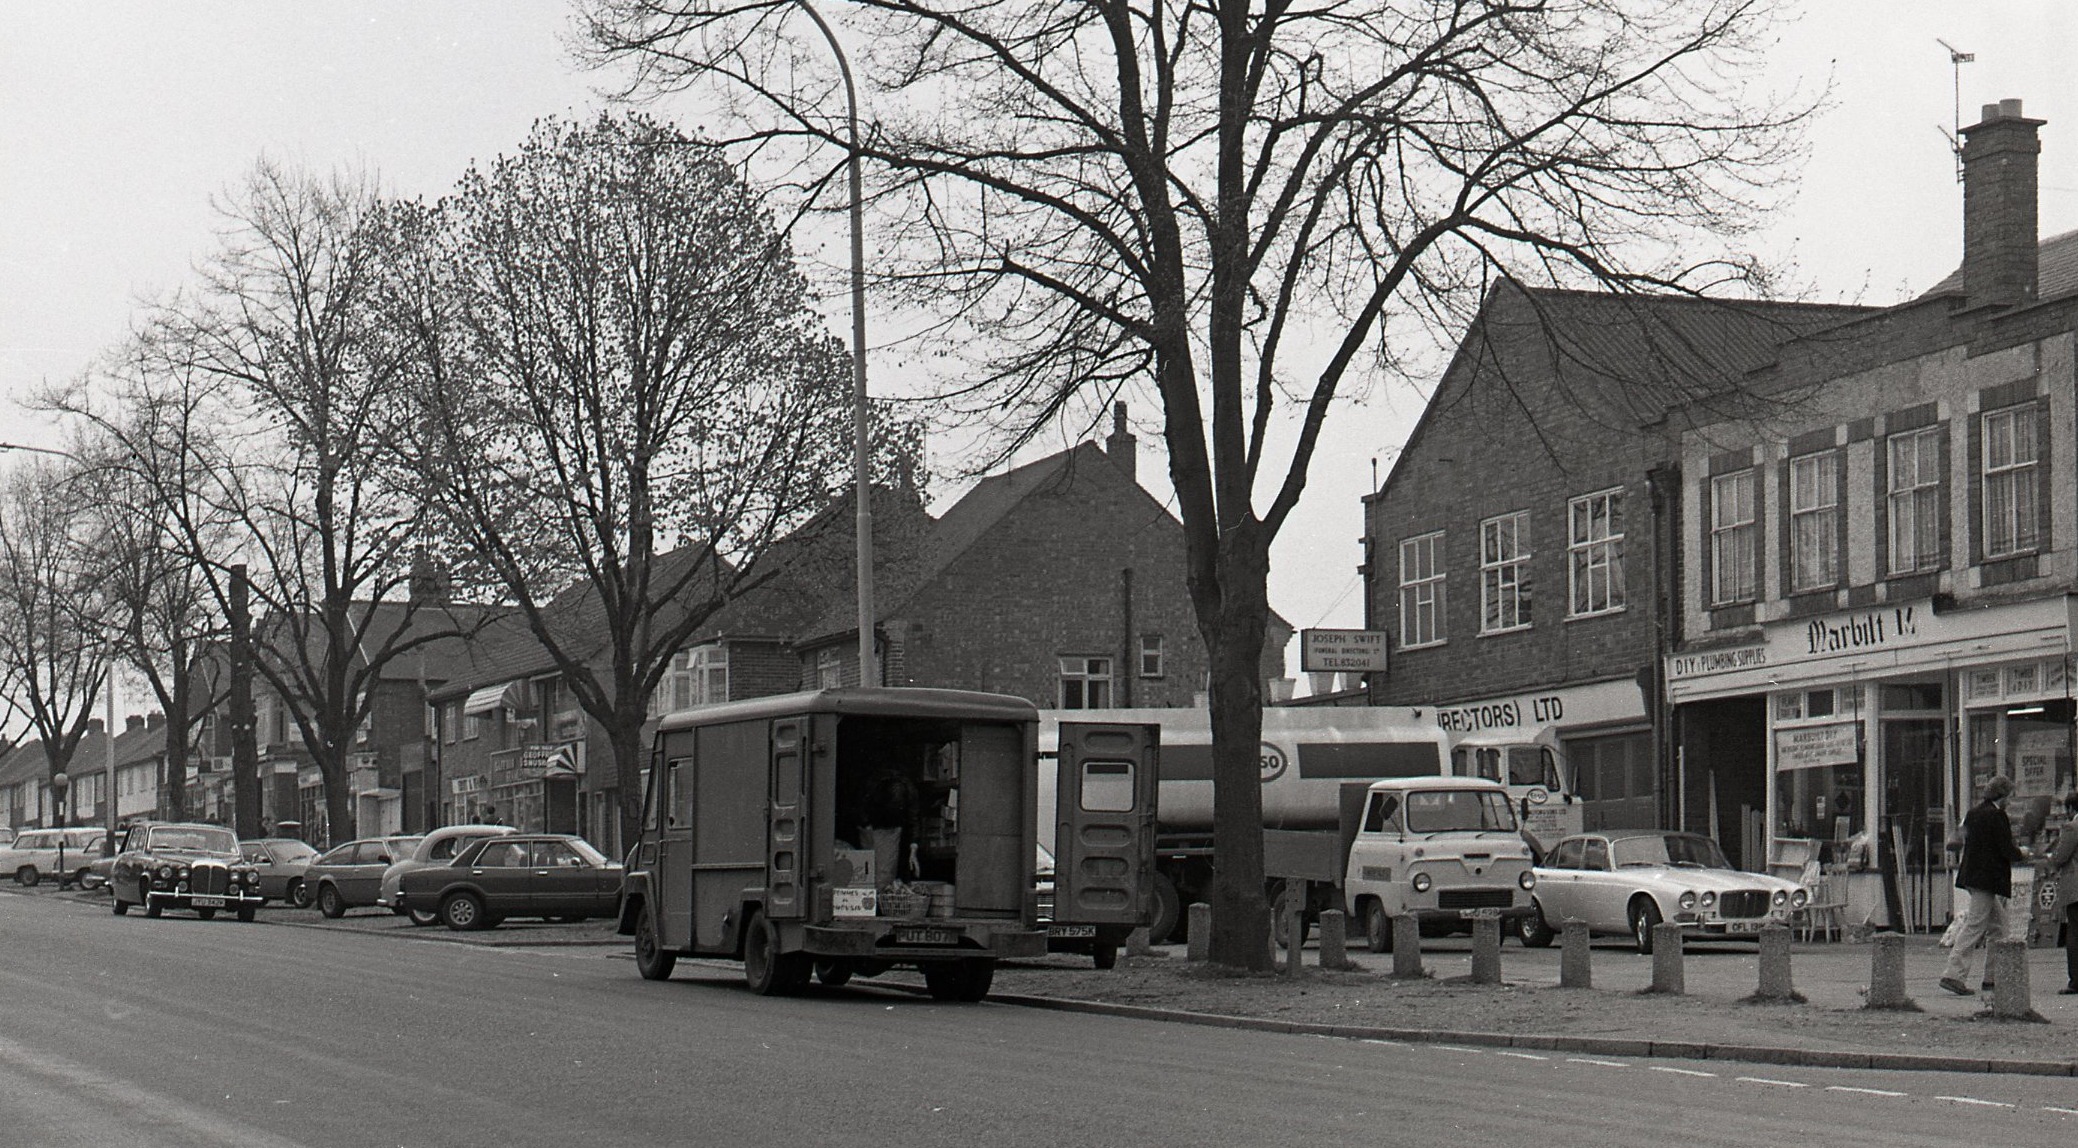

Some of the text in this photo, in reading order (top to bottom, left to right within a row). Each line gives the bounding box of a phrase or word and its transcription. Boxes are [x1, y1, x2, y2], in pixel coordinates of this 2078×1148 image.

[1807, 612, 1884, 654] Marbilt
[1313, 634, 1381, 644] JOSEPH SWIFT
[1701, 651, 1737, 671] PLUMBING
[1738, 647, 1766, 667] SUPPLIES
[1533, 696, 1563, 722] LTD
[523, 751, 552, 759] GEOFFR
[897, 929, 921, 940] PUT
[1049, 926, 1095, 936] BRY 575K
